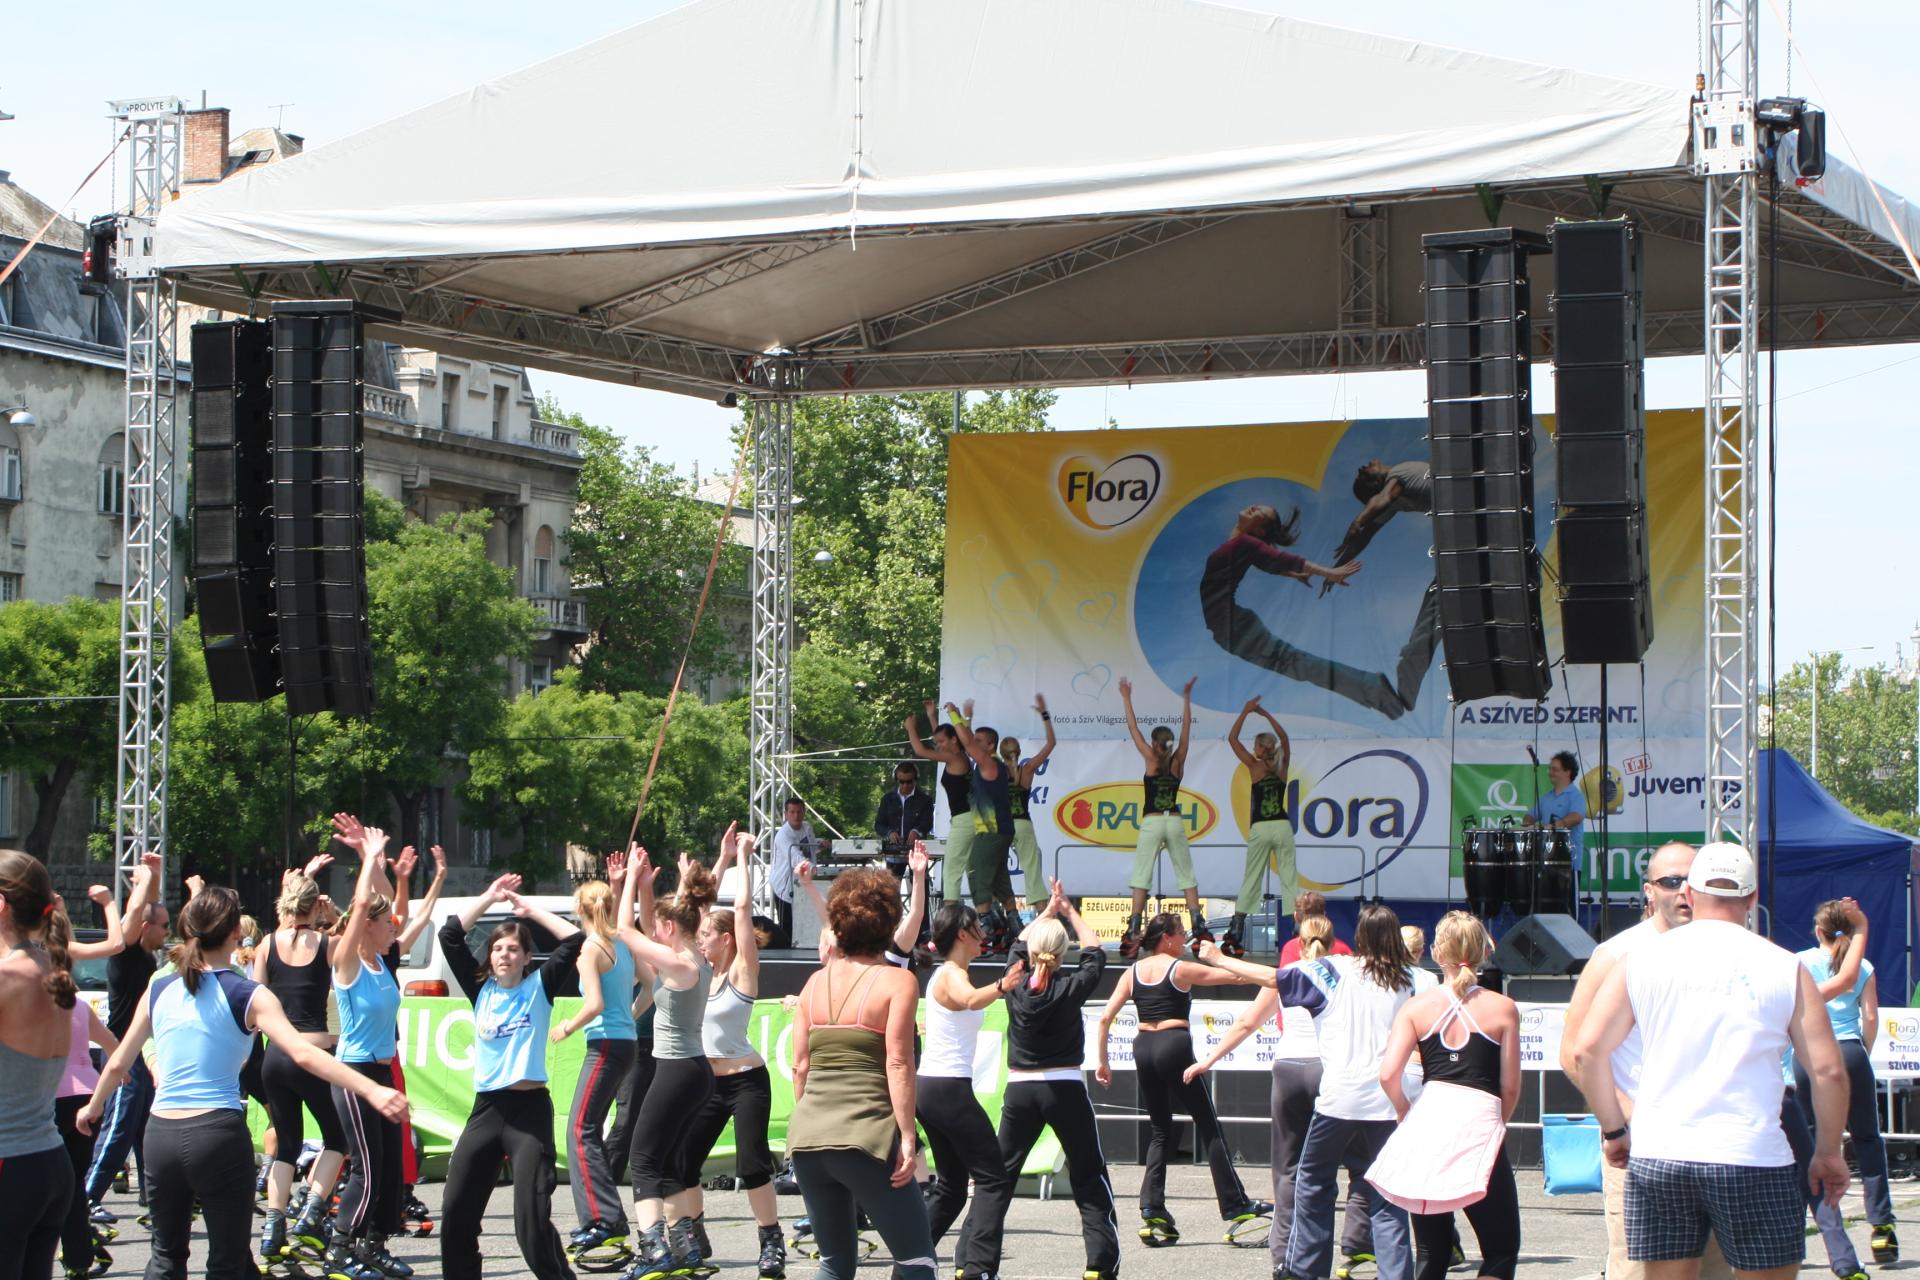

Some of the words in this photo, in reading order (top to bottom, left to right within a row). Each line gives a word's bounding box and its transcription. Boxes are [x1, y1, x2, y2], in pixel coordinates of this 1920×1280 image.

[129, 102, 164, 113] PROLYTE
[1067, 471, 1148, 502] Flora
[1460, 706, 1476, 724] A
[1479, 701, 1549, 724] SZÍVED
[1286, 779, 1405, 838] lora
[1115, 1017, 1134, 1027] lora
[1206, 1016, 1231, 1026] Flora
[1519, 1012, 1540, 1024] lora
[1889, 1021, 1916, 1033] Flora
[1520, 1035, 1543, 1043] ZERESD
